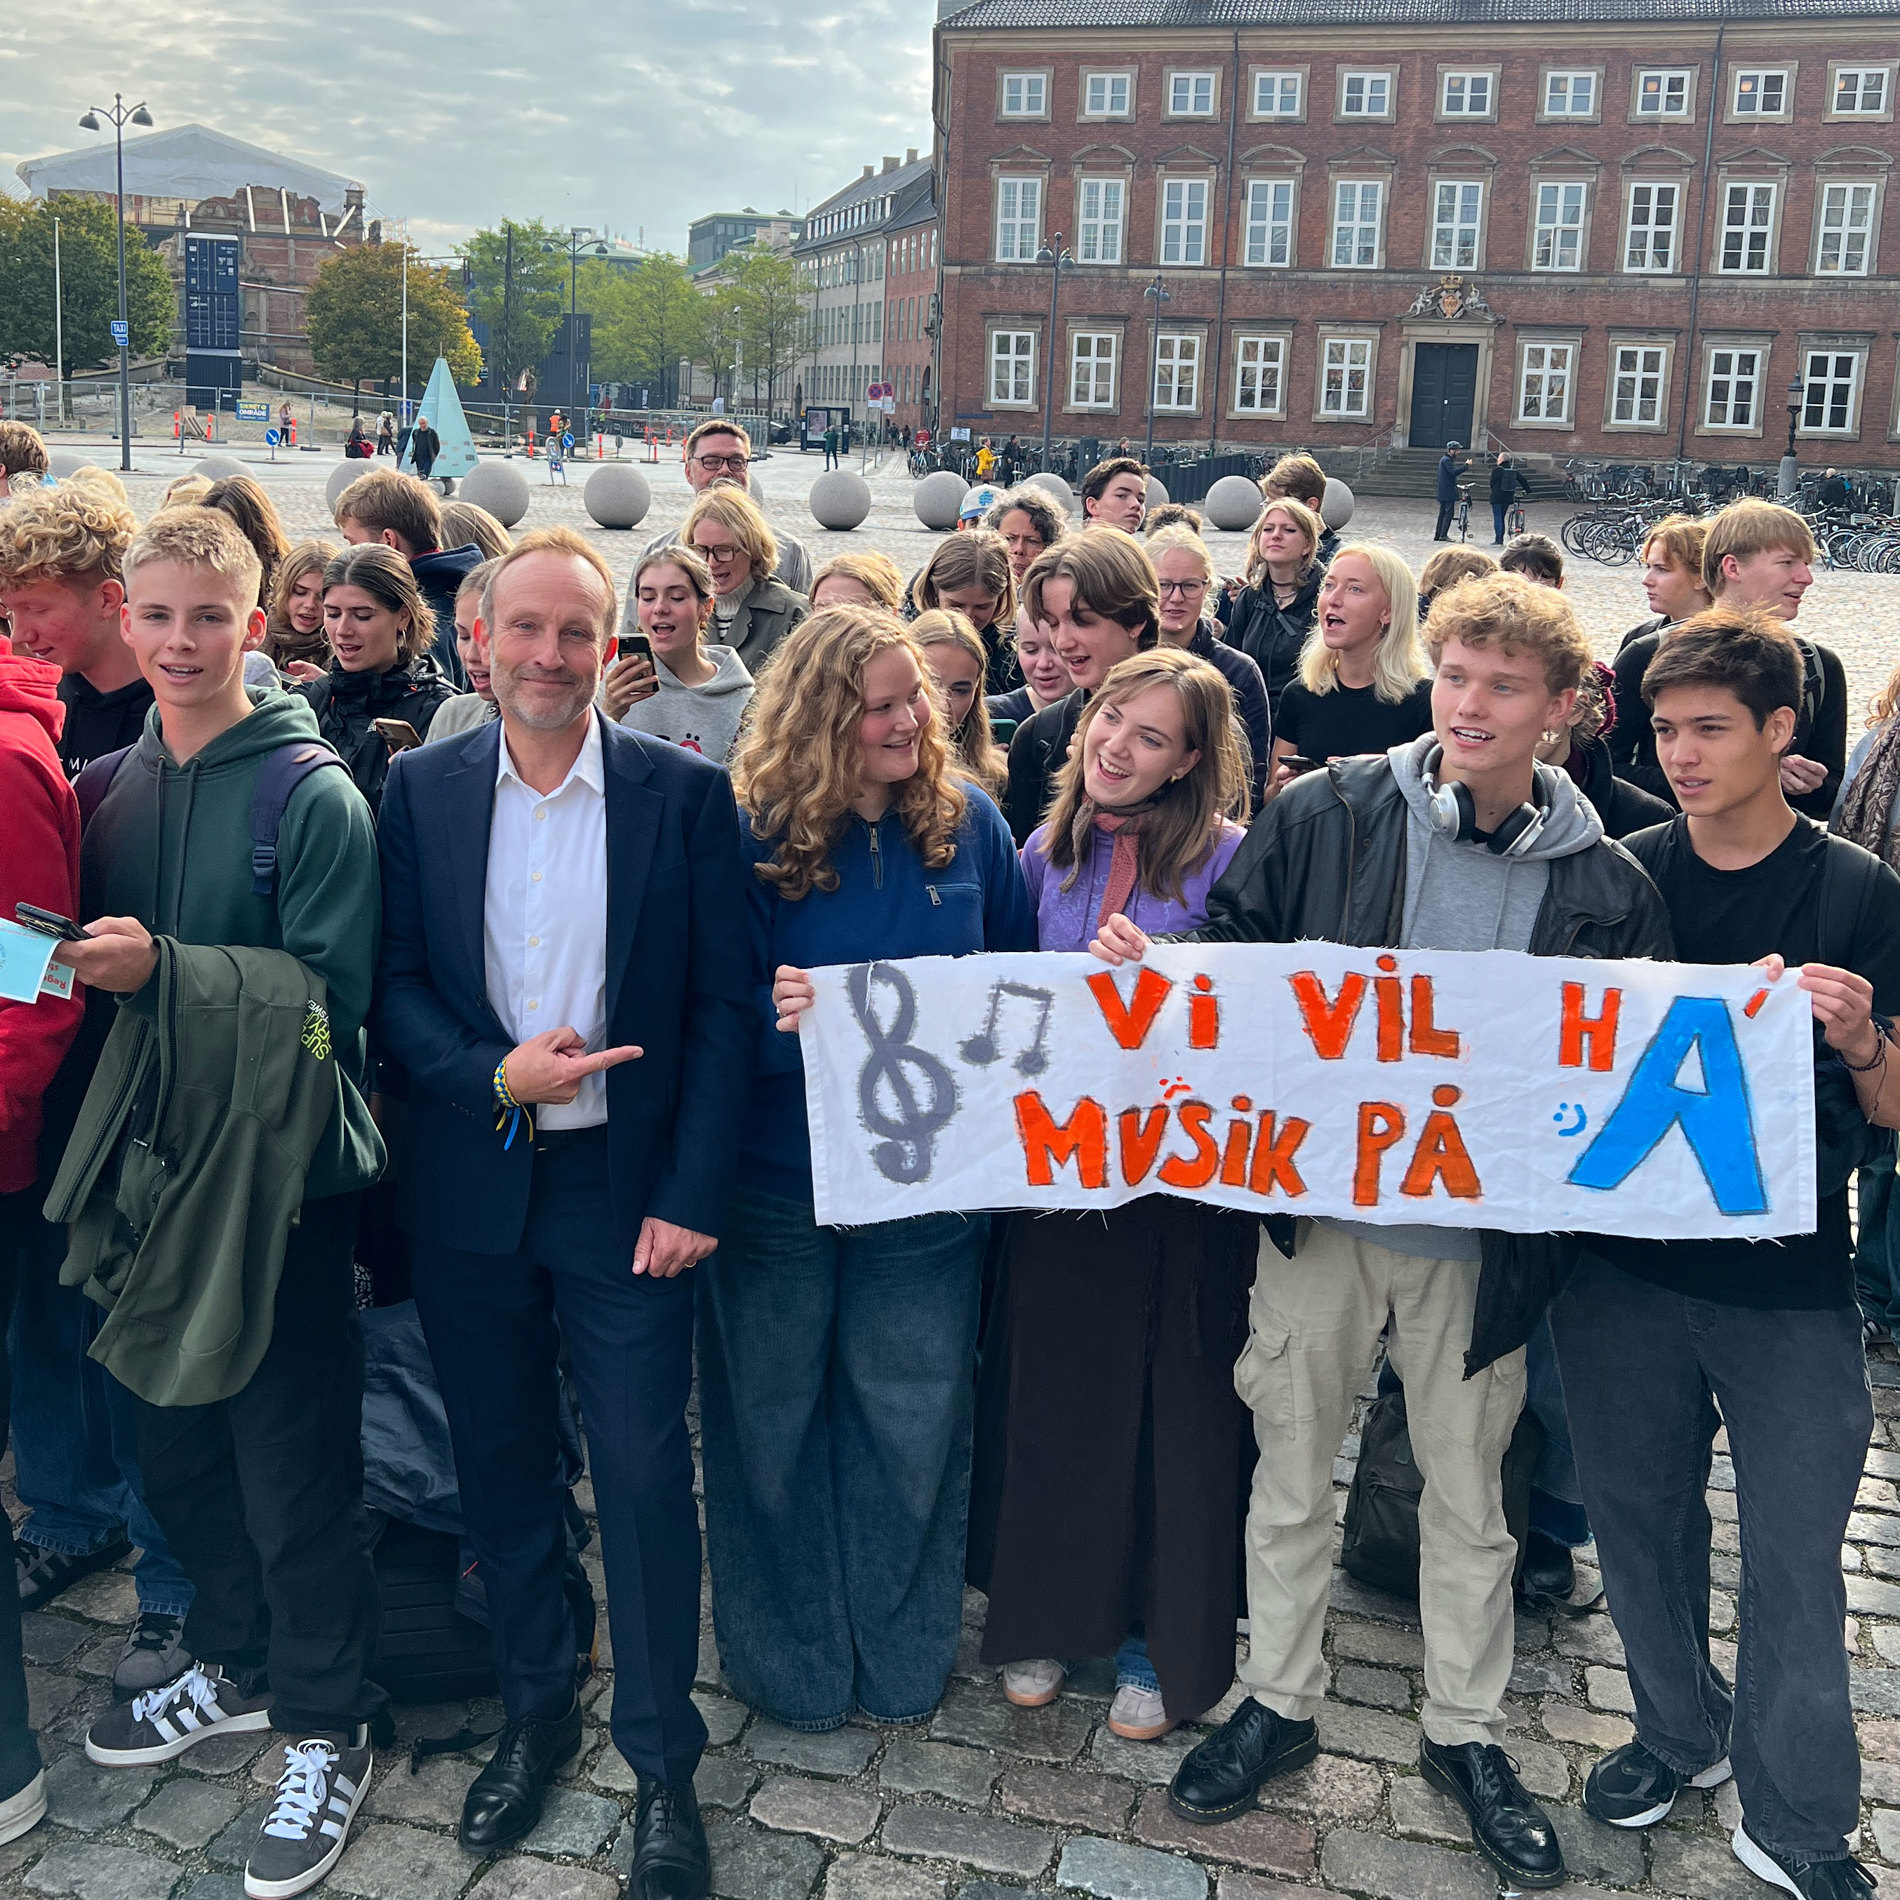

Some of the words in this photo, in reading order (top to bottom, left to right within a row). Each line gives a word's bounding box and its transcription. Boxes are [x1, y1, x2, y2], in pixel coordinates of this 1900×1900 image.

[113, 323, 127, 333] TAXI
[301, 1025, 330, 1060] SUP
[1353, 1084, 1484, 1206] PÅ
